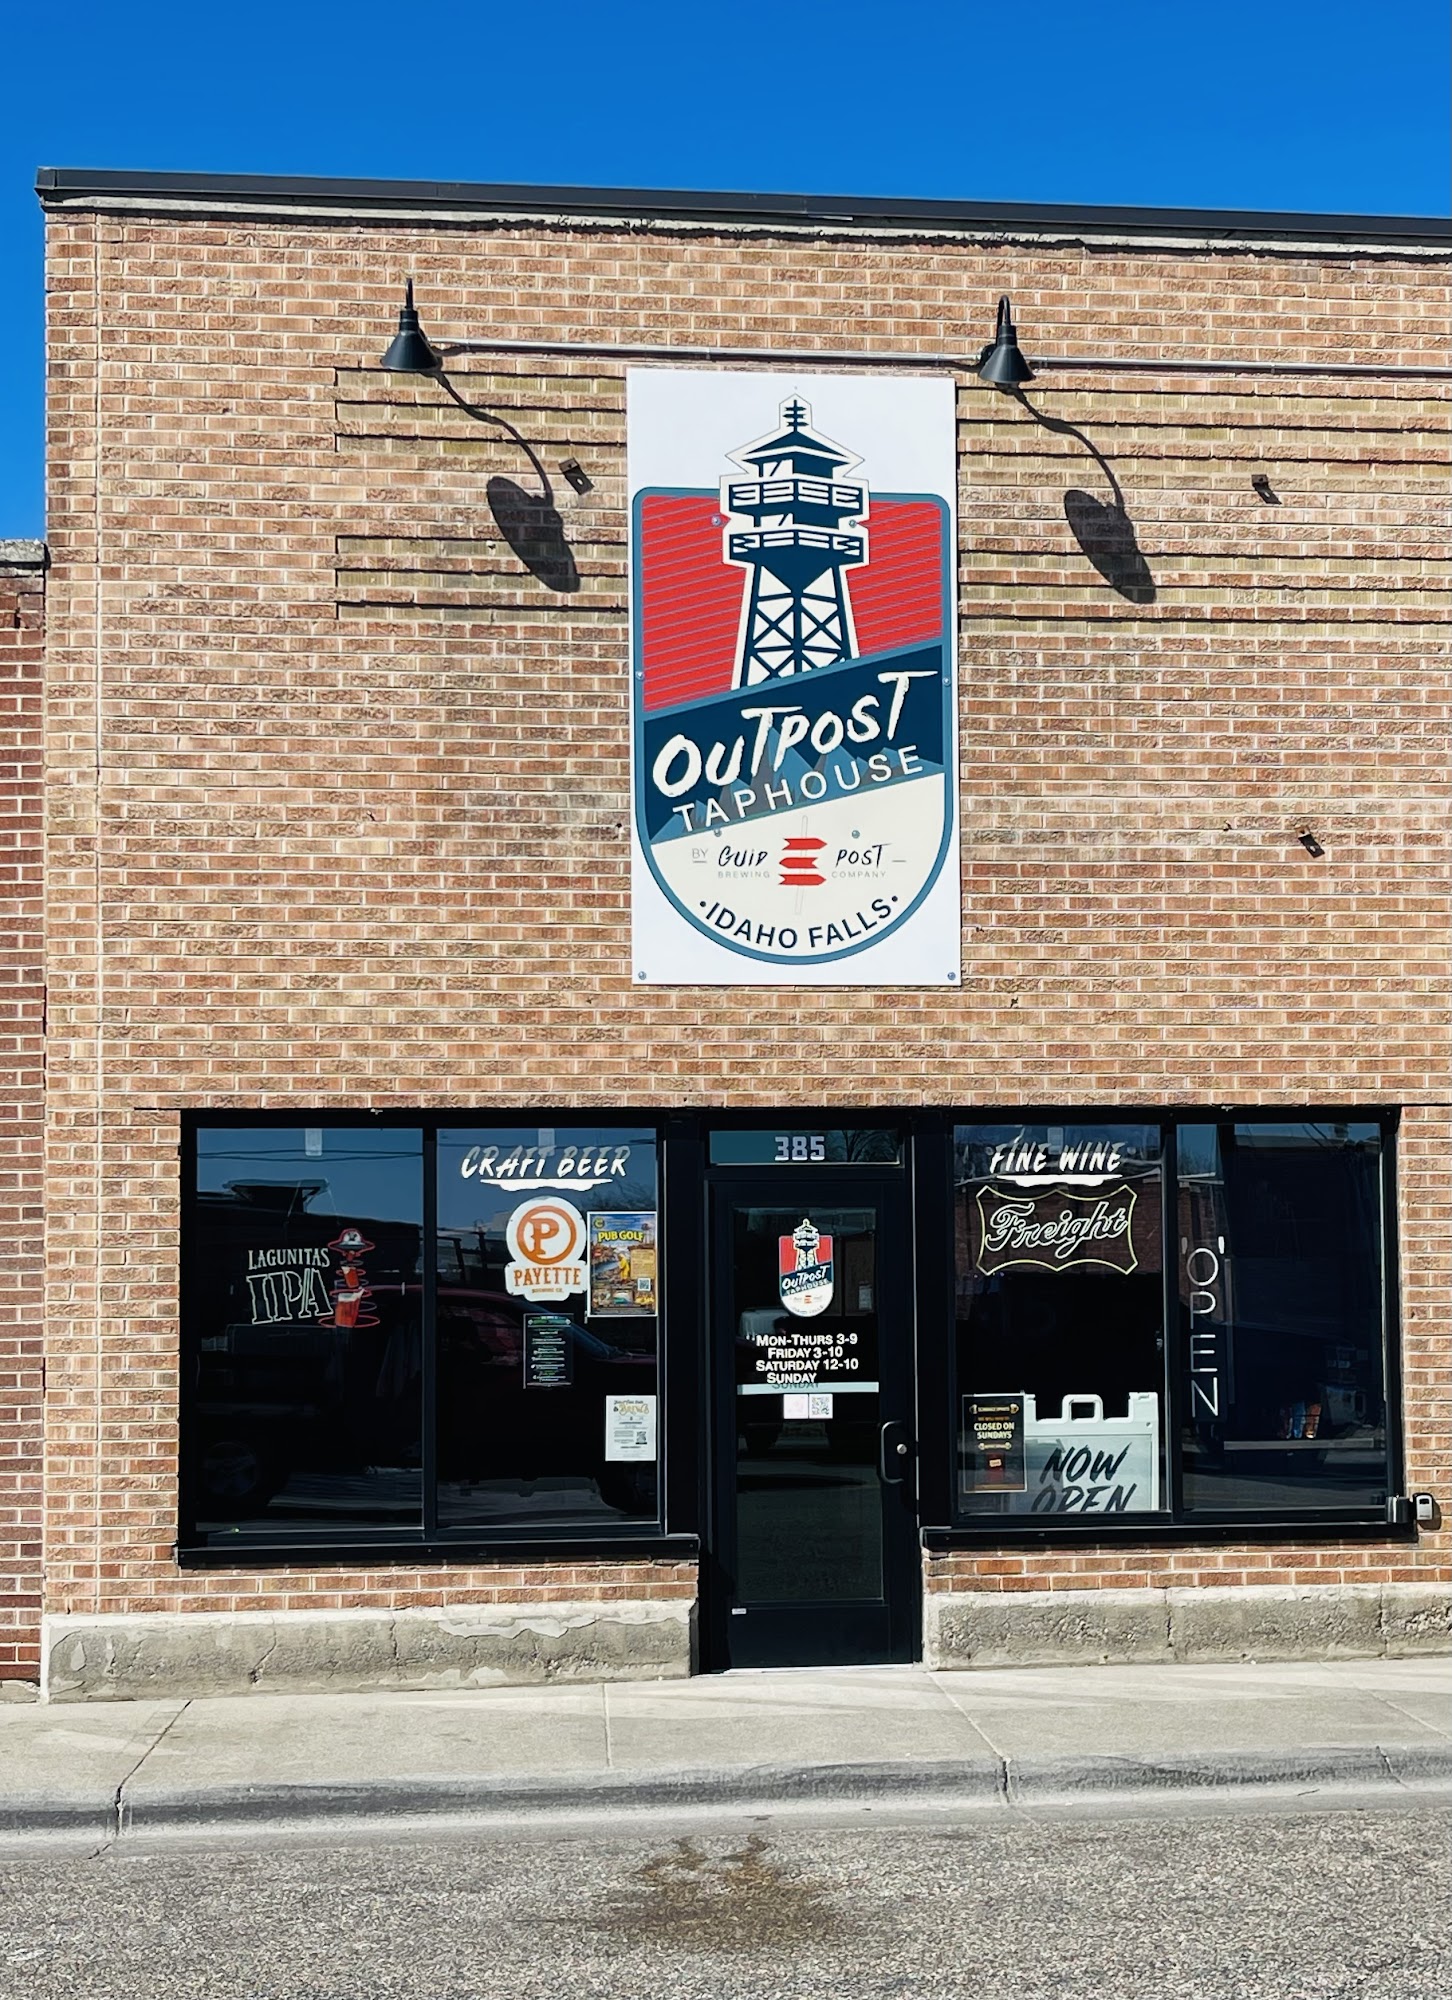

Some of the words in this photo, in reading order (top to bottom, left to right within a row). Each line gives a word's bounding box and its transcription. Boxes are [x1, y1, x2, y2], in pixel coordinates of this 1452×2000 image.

[652, 671, 938, 797] OUTPOST
[672, 745, 923, 832] TAPHOUSE
[692, 848, 709, 859] BY
[835, 843, 892, 868] POST
[705, 902, 797, 949] IDAHO
[809, 898, 892, 948] FALLS
[774, 1136, 825, 1161] 385
[989, 1141, 1051, 1173] FINE
[1059, 1140, 1127, 1172] WINE
[461, 1145, 556, 1178] CRAFT
[557, 1145, 631, 1178] BEER
[598, 1231, 617, 1242] PUB
[619, 1230, 644, 1242] GOLF
[985, 1201, 1129, 1259] Freight
[248, 1248, 330, 1270] LAGUNITAS
[514, 1267, 581, 1286] PAYETTE
[782, 1265, 830, 1290] OUTPOST
[246, 1268, 334, 1325] IPA
[756, 1334, 833, 1346] MON-THURS
[836, 1333, 858, 1344] 3-9
[1186, 1247, 1219, 1418] OPEN
[756, 1360, 820, 1371] SATURDAY
[823, 1358, 859, 1370] 12-10
[768, 1347, 811, 1359] FRIDAY
[813, 1346, 843, 1358] 3-10
[767, 1372, 817, 1384] SUNDAY
[974, 1422, 1002, 1431] CLOSED
[1003, 1422, 1014, 1431] ON
[977, 1431, 1012, 1440] SUNDAYS
[1040, 1442, 1132, 1484] NOW
[1031, 1483, 1137, 1512] OPEN
